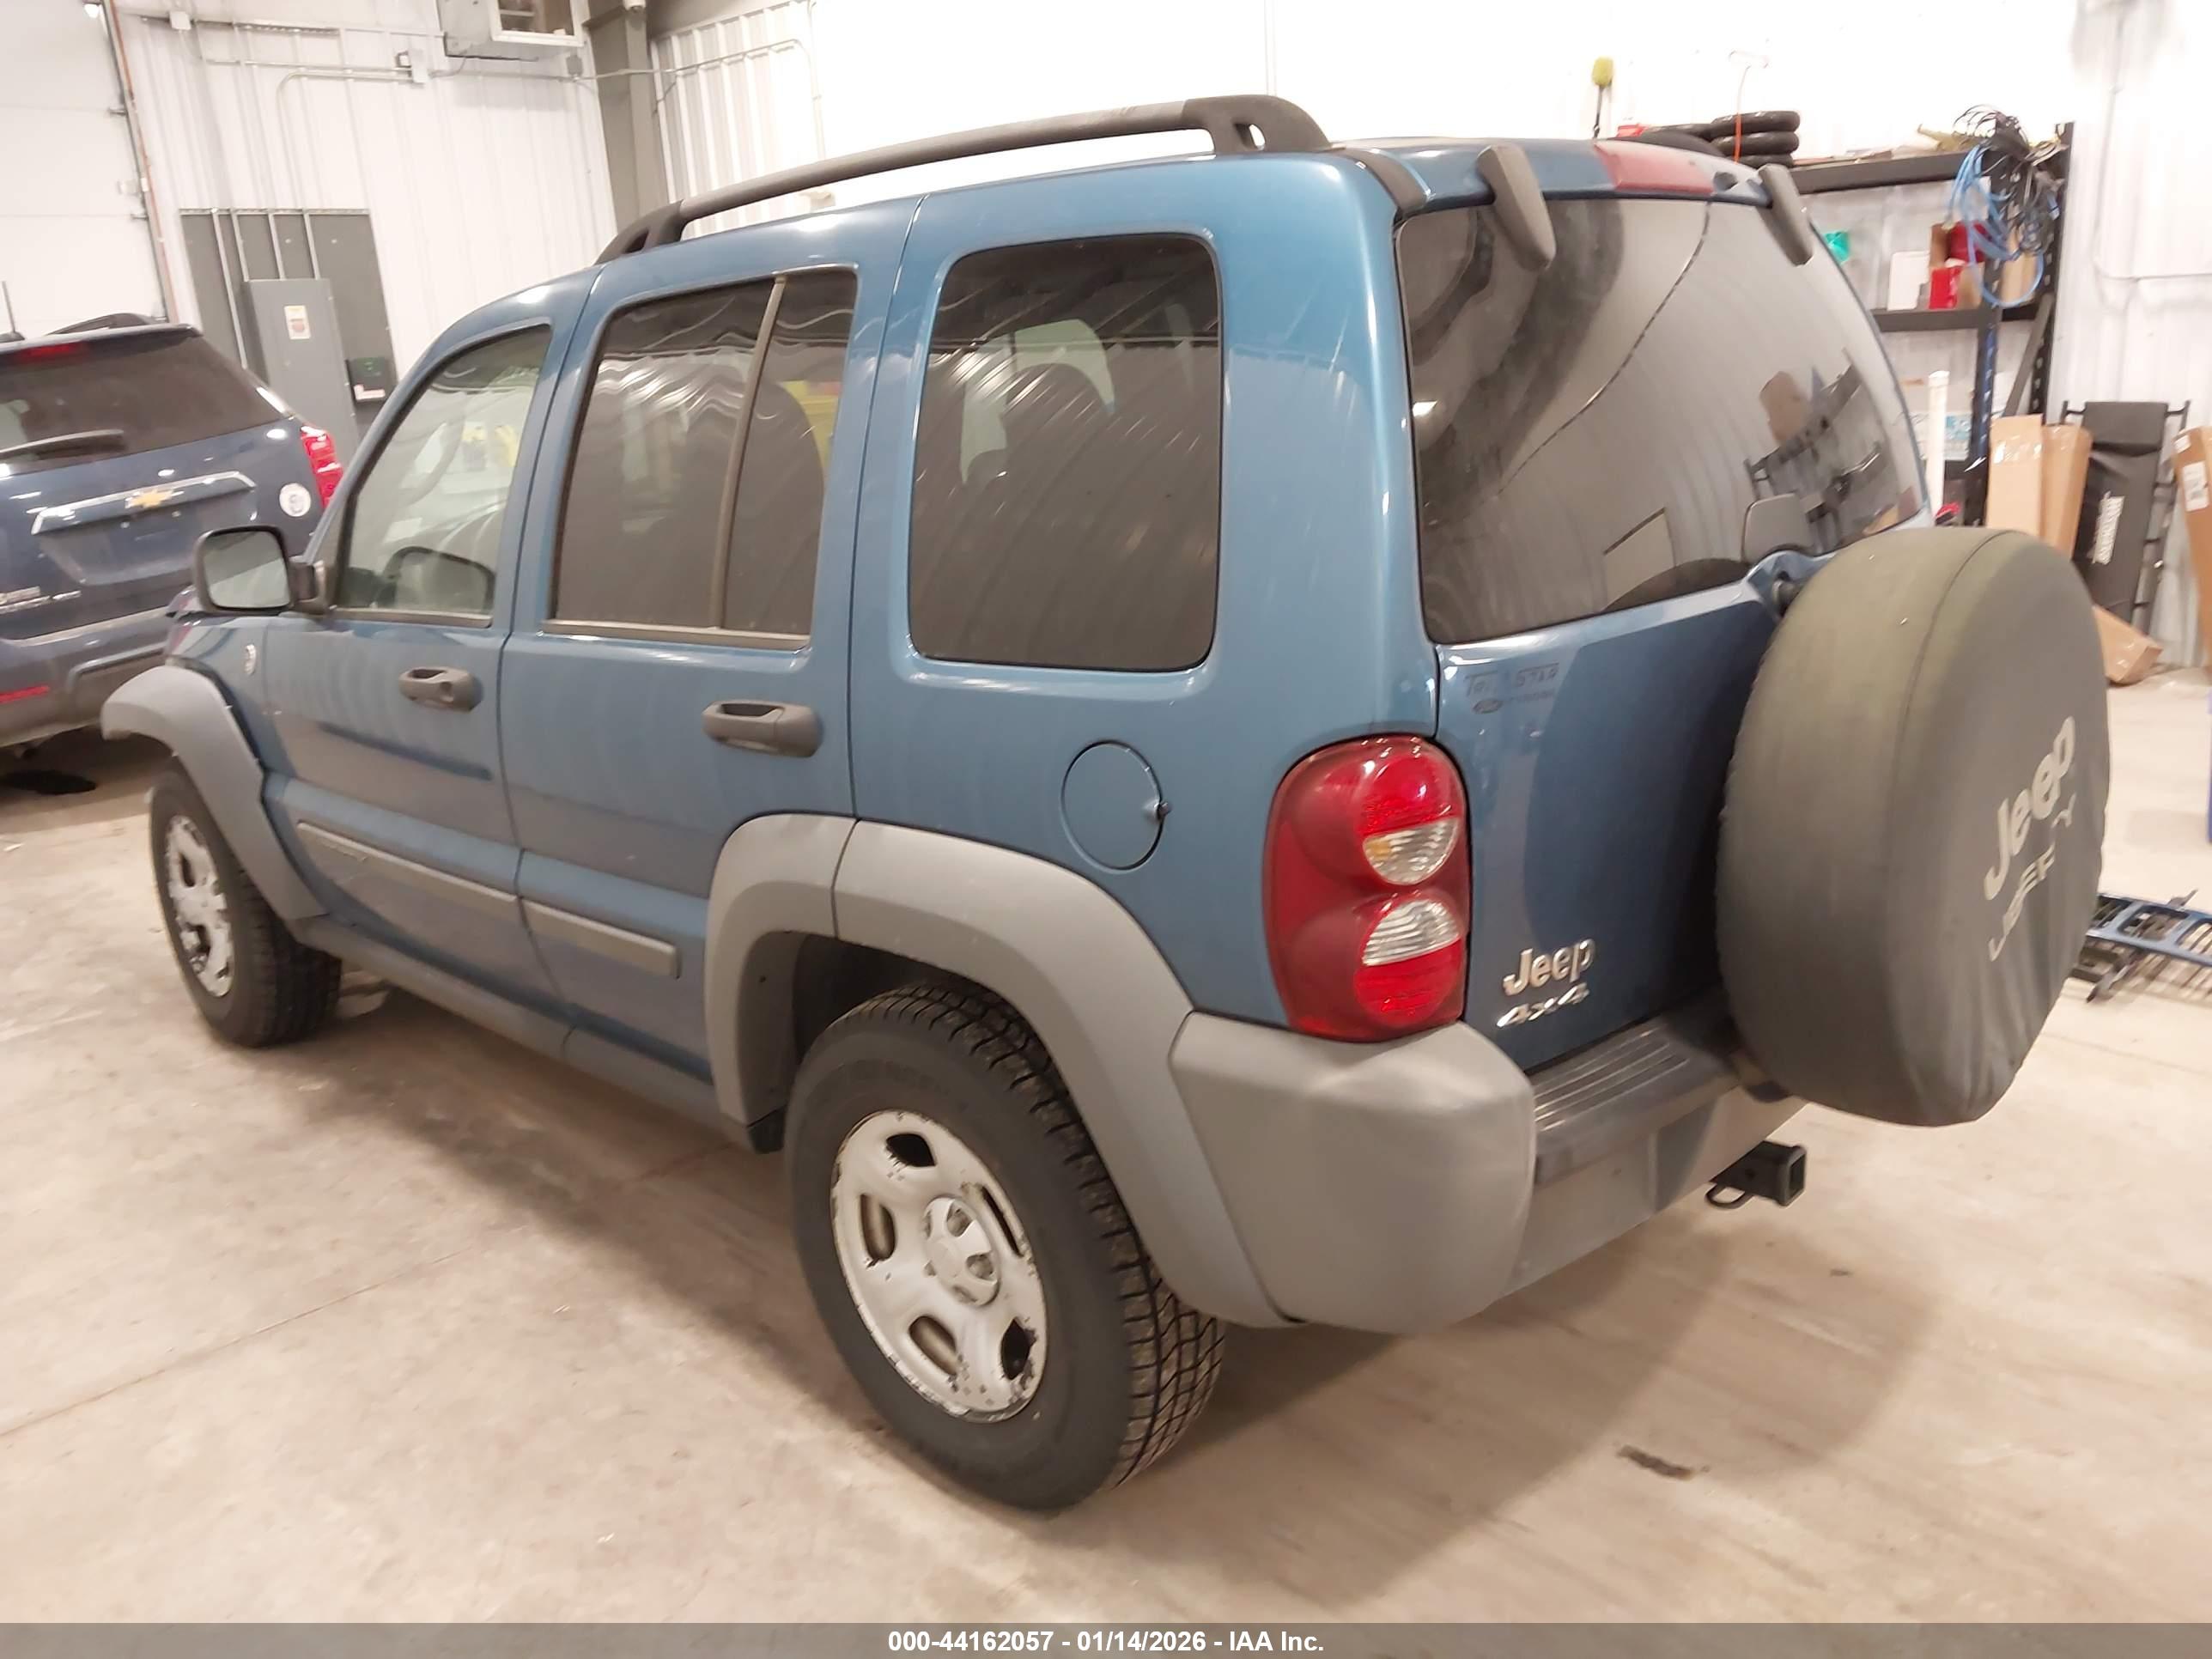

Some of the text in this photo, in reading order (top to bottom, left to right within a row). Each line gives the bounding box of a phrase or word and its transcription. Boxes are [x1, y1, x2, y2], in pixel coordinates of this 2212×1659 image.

[1984, 715, 2075, 901] Jeep
[1988, 792, 2077, 963] LIBERY
[1497, 982, 1590, 1028] 4x4
[1503, 939, 1595, 996] Jeep
